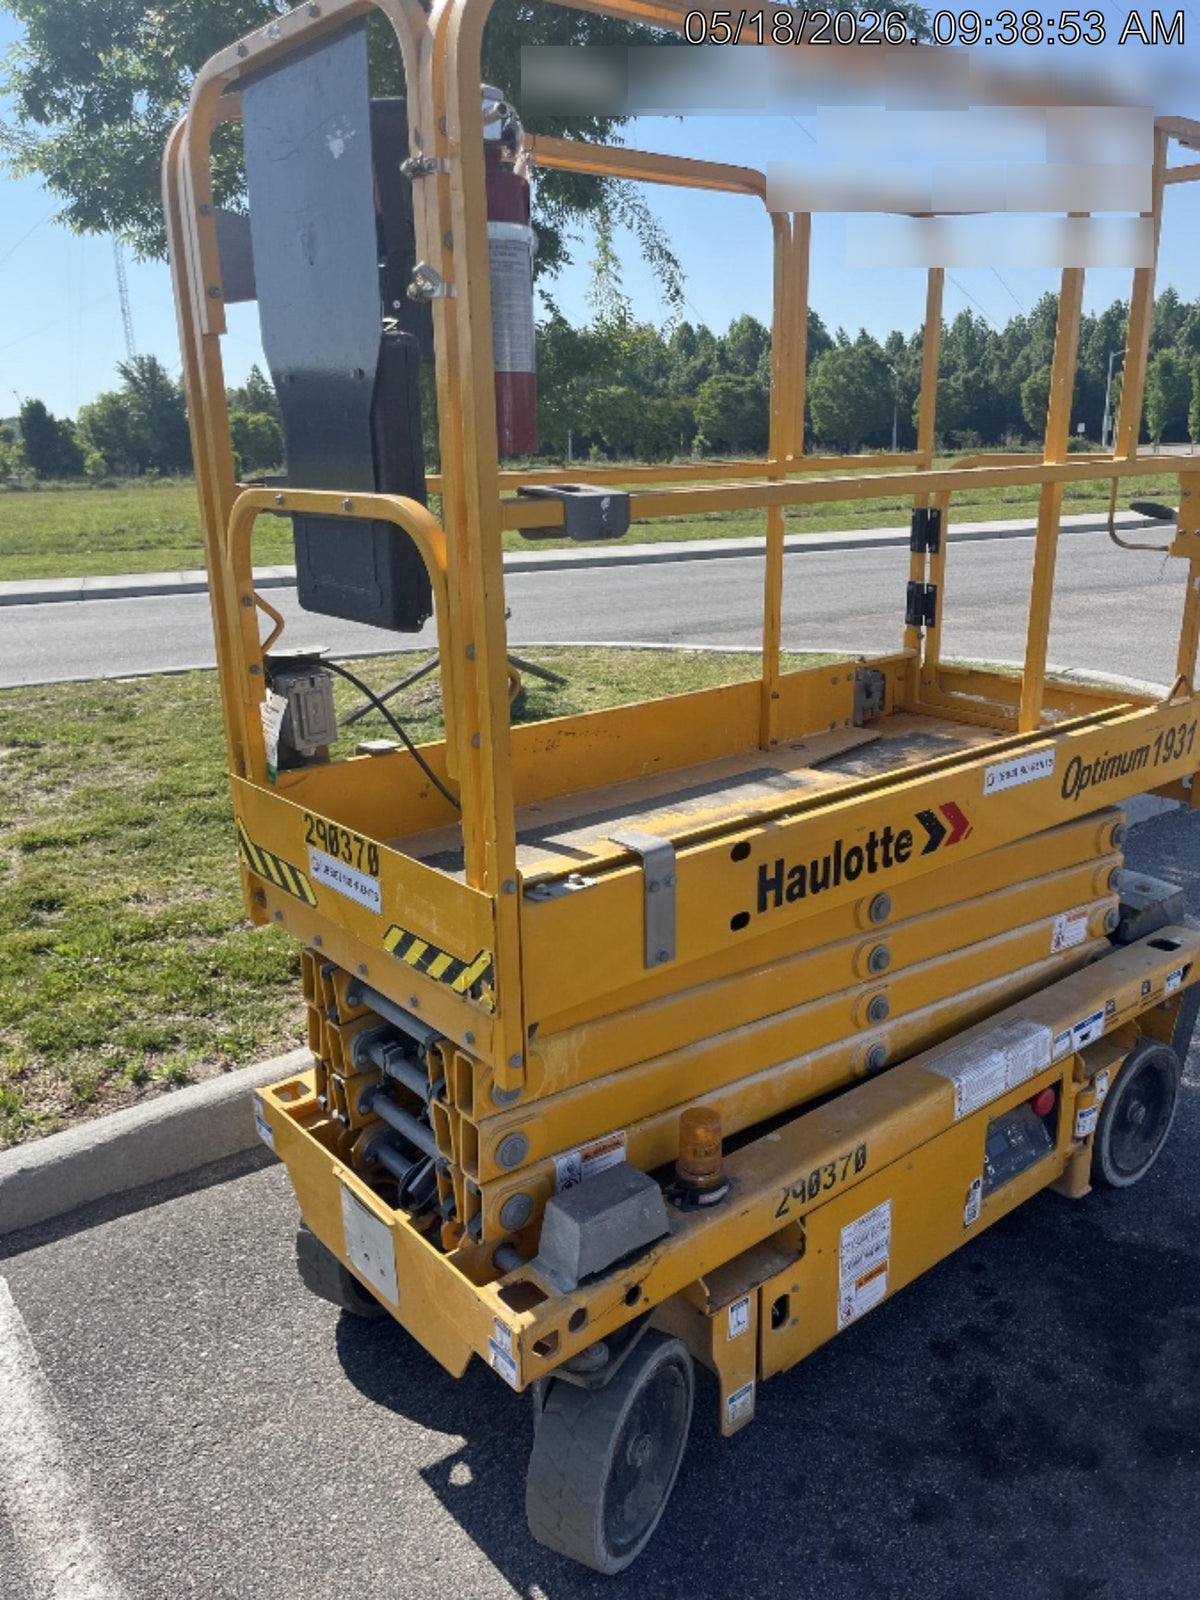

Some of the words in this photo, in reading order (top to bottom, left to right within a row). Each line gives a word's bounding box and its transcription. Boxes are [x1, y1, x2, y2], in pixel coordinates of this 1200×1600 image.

[1061, 744, 1151, 802] Optimum
[1153, 719, 1198, 767] 1931
[303, 812, 380, 878] 290370
[757, 826, 913, 914] Haulotte
[775, 1142, 867, 1218] 290370
